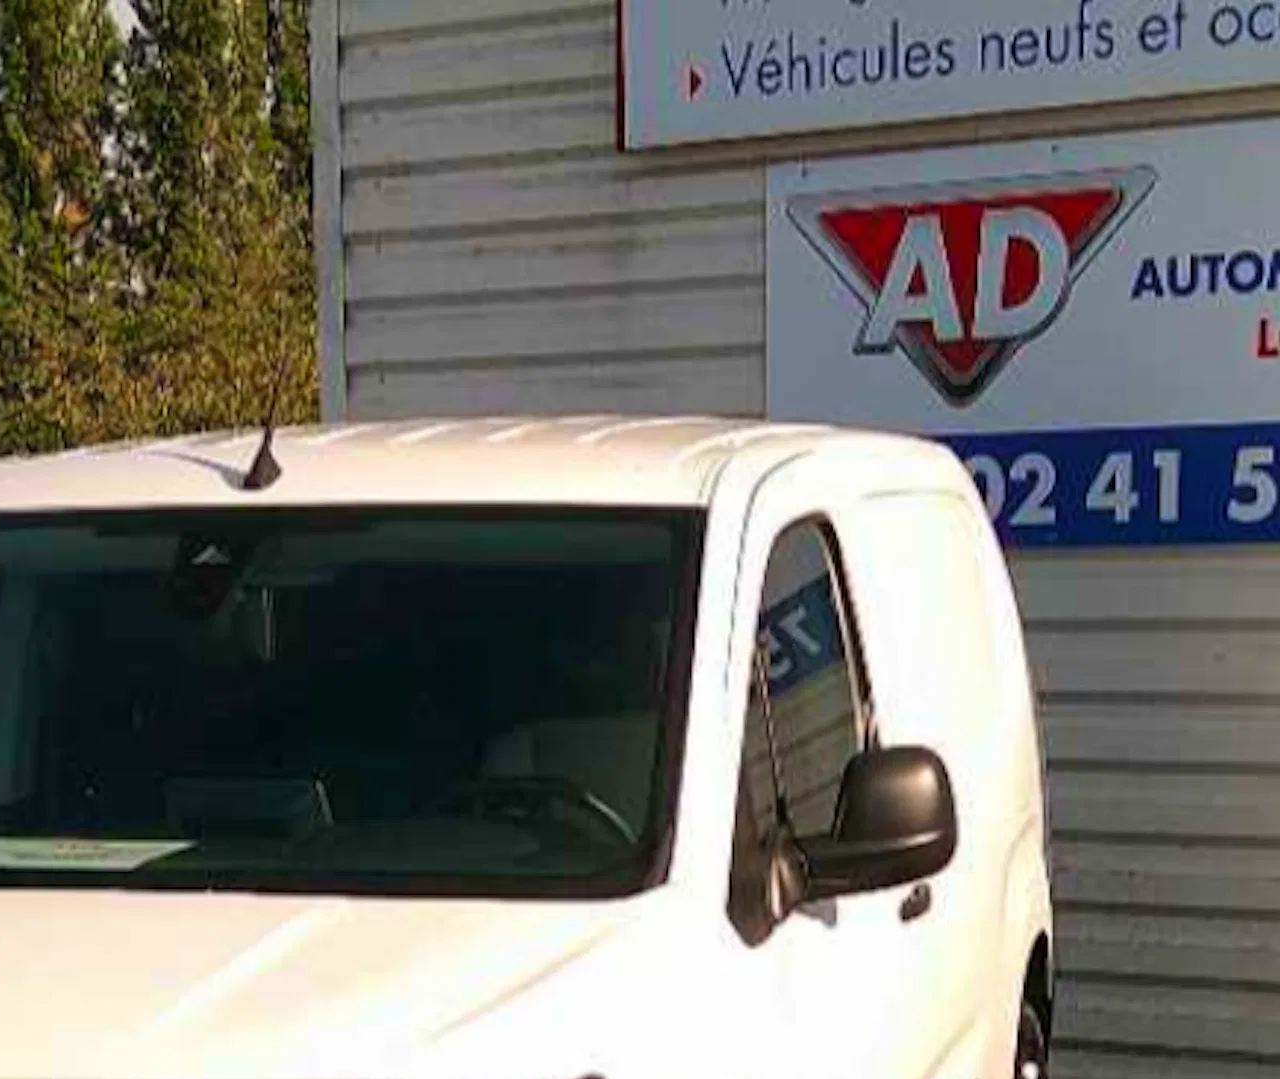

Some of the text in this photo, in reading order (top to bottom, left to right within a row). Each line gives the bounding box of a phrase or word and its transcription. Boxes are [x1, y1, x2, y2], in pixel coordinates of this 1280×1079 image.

[721, 17, 956, 98] Véhicules
[979, 0, 1115, 72] neufs
[1137, 0, 1188, 51] et
[857, 206, 1072, 349] AD
[970, 451, 1057, 527] 02
[1085, 448, 1183, 525] 41
